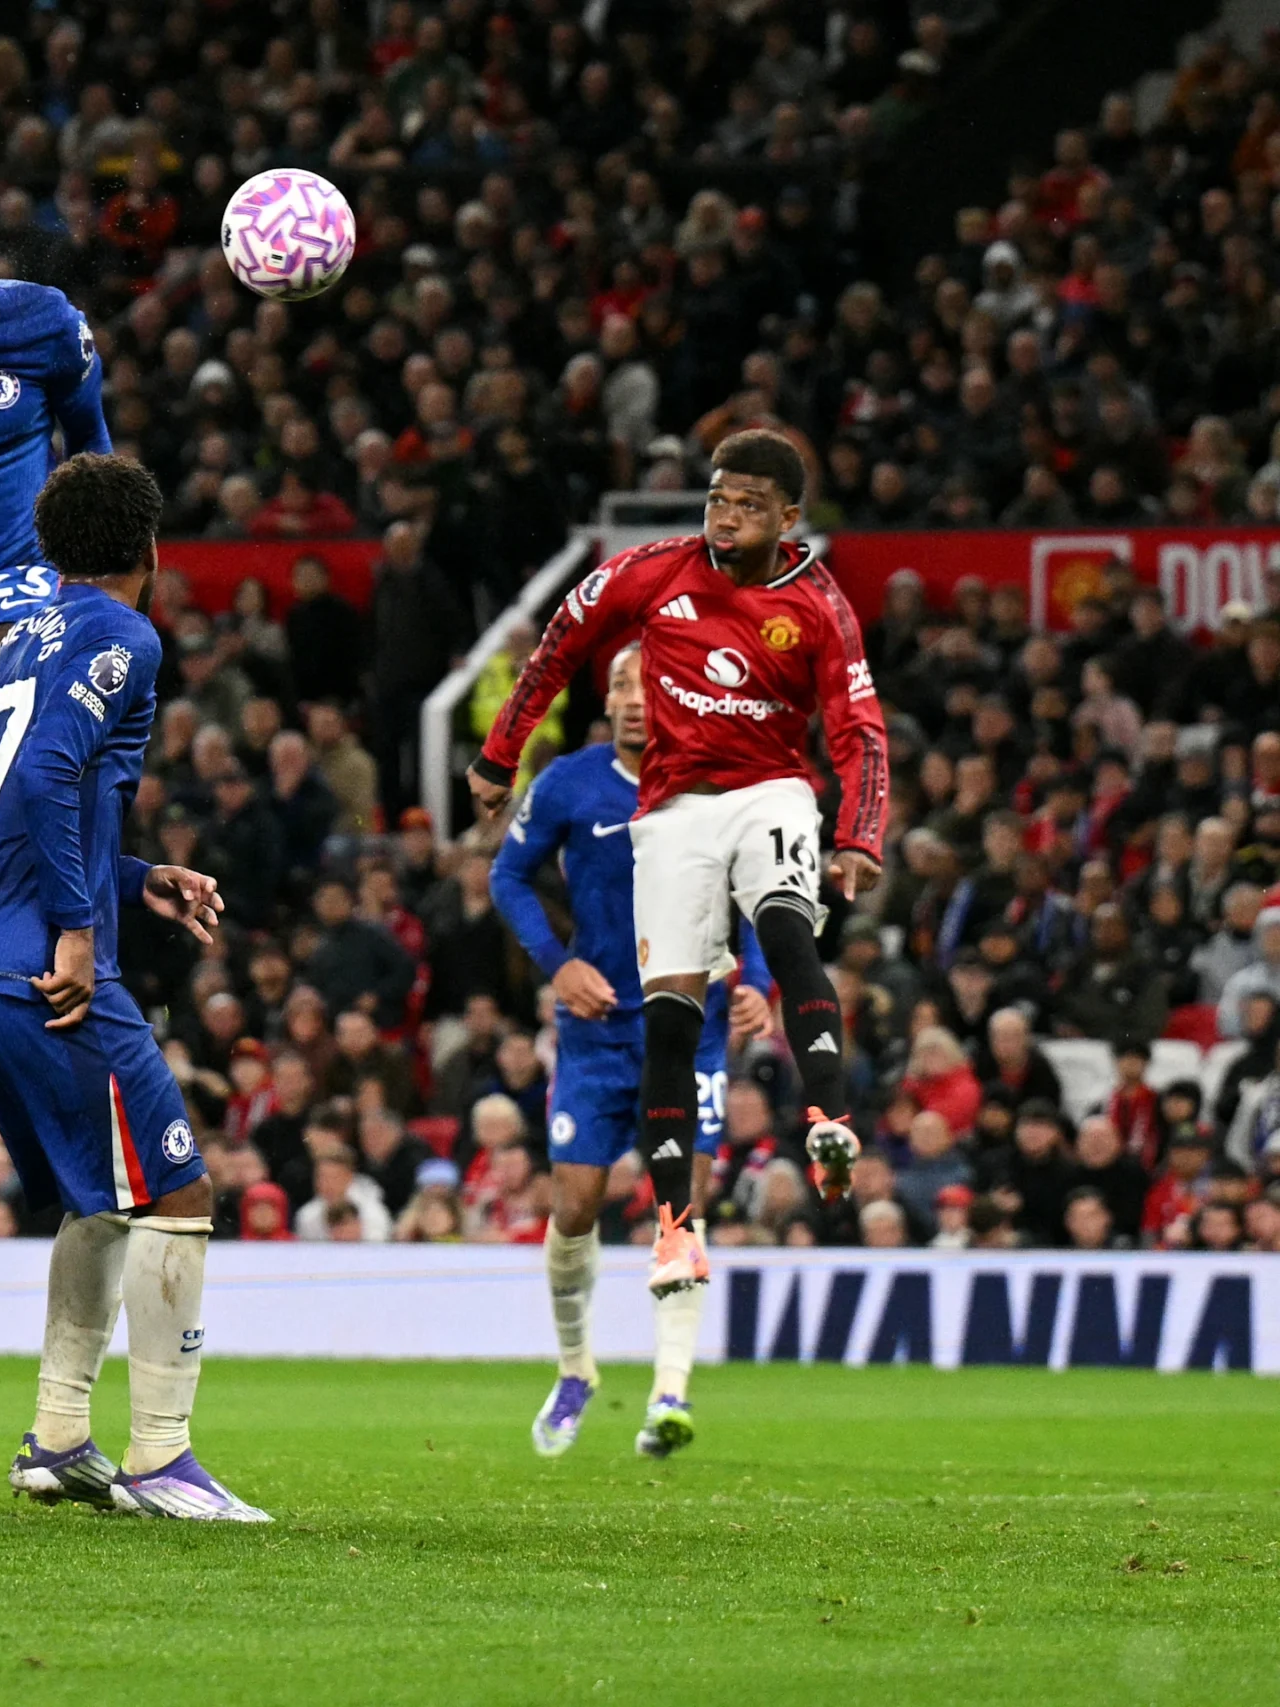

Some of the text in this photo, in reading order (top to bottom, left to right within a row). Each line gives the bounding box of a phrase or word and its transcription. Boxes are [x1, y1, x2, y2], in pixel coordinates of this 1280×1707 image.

[70, 681, 106, 714] No room
[768, 826, 816, 872] 16
[727, 1267, 1254, 1369] WANNA
